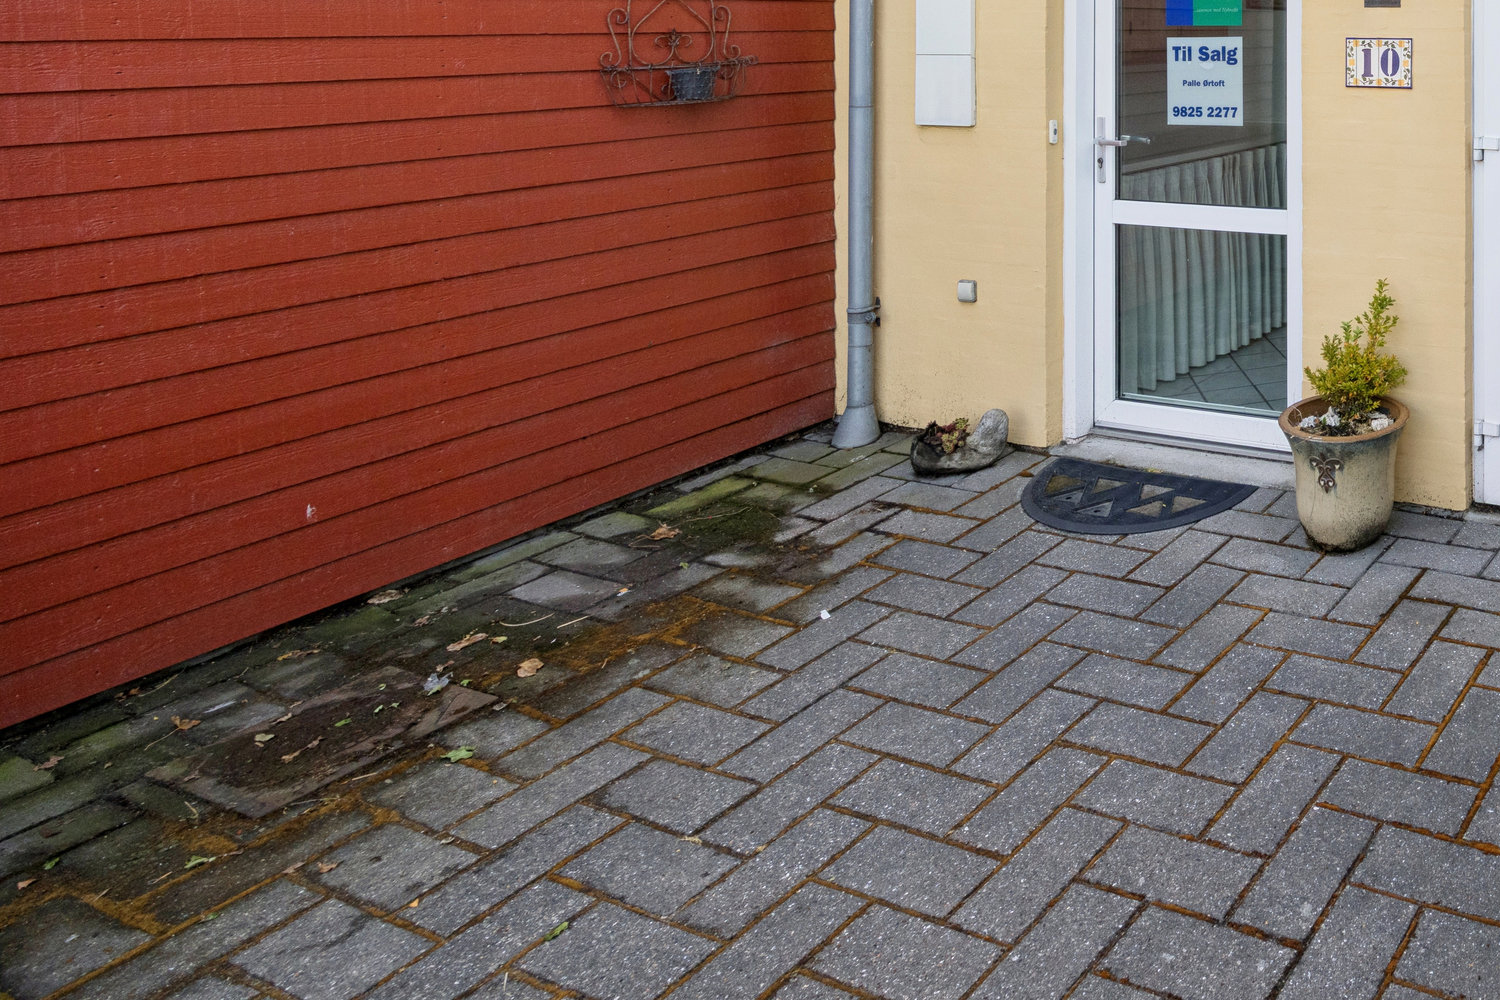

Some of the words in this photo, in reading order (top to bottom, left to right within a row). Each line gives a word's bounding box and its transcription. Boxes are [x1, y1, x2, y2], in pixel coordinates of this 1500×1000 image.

[1172, 46, 1193, 62] Til
[1198, 46, 1238, 66] Salg
[1361, 47, 1400, 78] 10
[1202, 79, 1225, 88] Ørtoft
[1172, 106, 1203, 118] 9825
[1206, 106, 1238, 118] 2277
